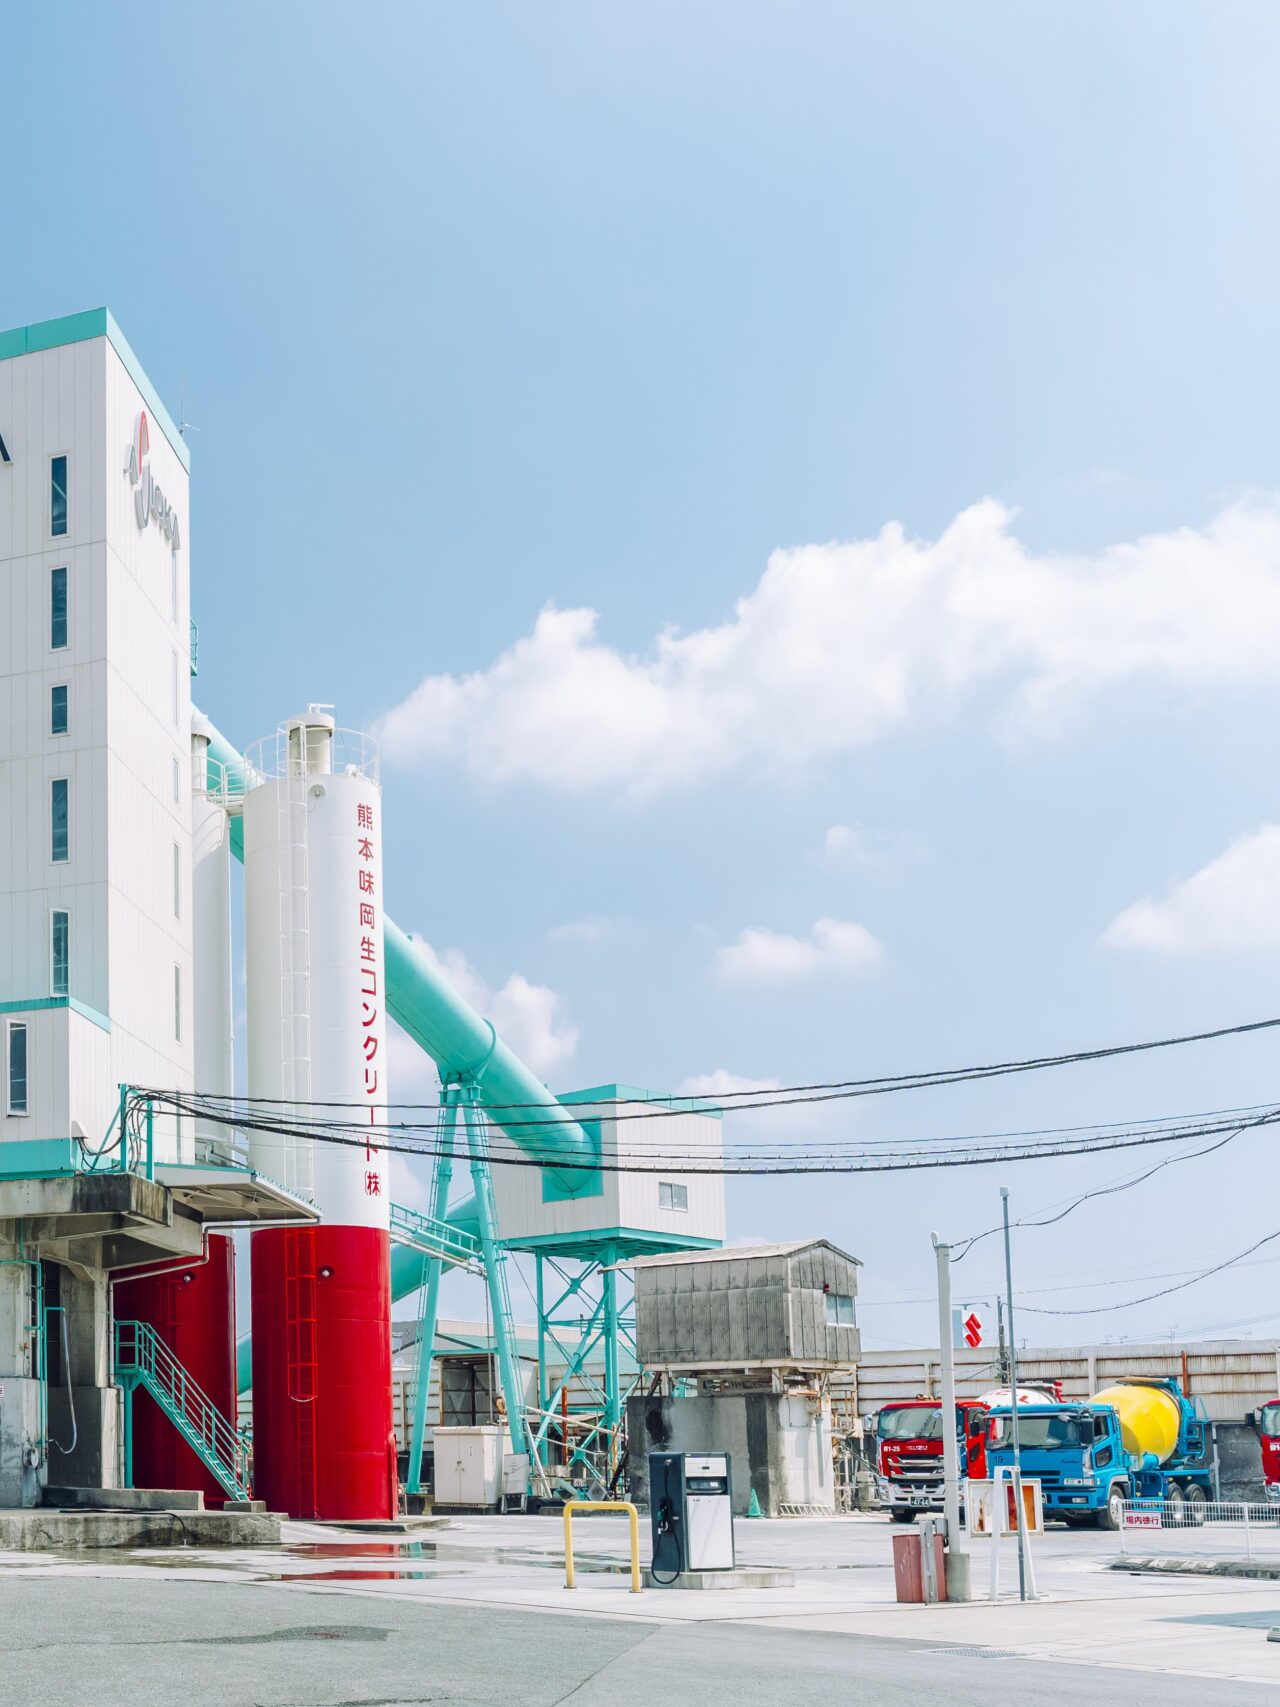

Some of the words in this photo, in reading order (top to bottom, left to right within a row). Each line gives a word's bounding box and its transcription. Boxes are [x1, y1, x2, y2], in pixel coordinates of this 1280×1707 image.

[994, 1455, 1004, 1463] 19
[1125, 1515, 1160, 1525] 場内徐行
